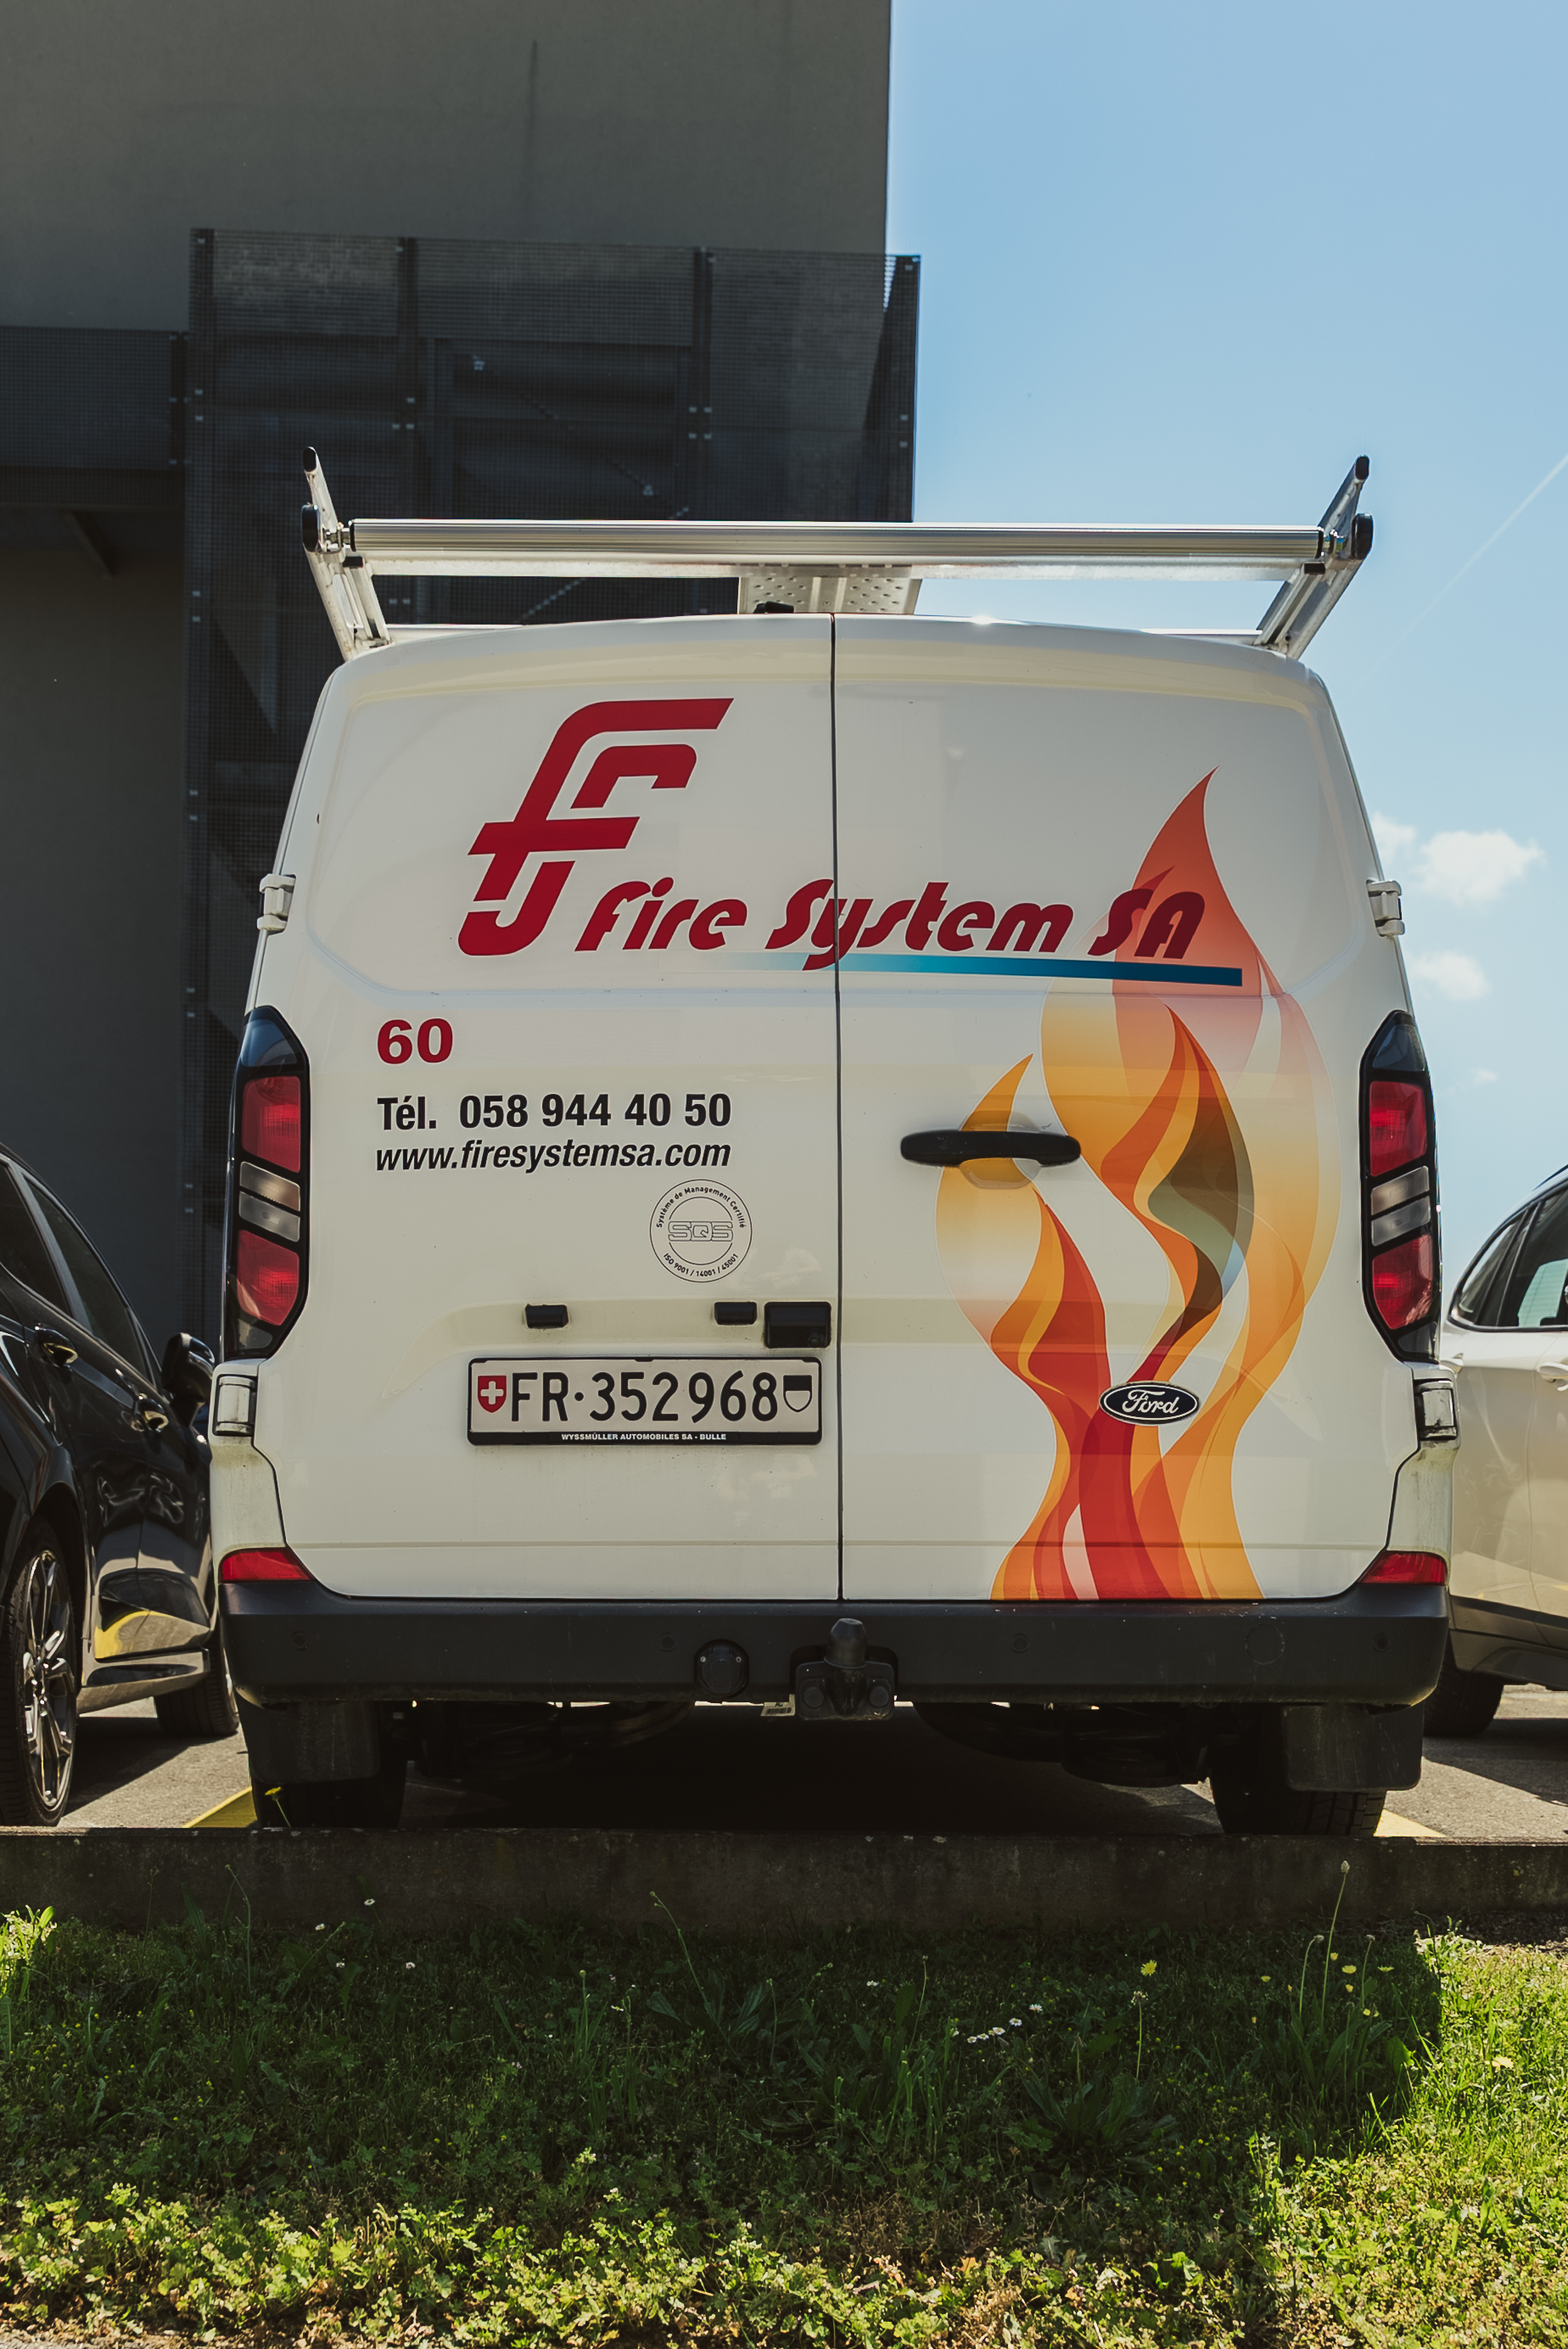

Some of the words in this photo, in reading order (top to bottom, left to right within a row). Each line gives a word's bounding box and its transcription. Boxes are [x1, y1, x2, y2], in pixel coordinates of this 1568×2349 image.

[764, 878, 1073, 971] System
[1087, 888, 1206, 960] SA
[377, 1018, 454, 1064] 60
[377, 1096, 437, 1130] Tél.
[459, 1095, 529, 1128] 058
[541, 1094, 612, 1126] 944
[624, 1093, 671, 1126] 40
[684, 1093, 731, 1126] 50
[376, 1140, 731, 1174] www.firesystemsa.com
[656, 1198, 675, 1228] Système
[685, 1186, 731, 1203] Management
[668, 1220, 733, 1242] SQS
[664, 1253, 675, 1265] ISO
[674, 1262, 689, 1275] 9001
[696, 1269, 715, 1277] 14001
[722, 1253, 738, 1270] 45001
[1122, 1389, 1180, 1414] Ford
